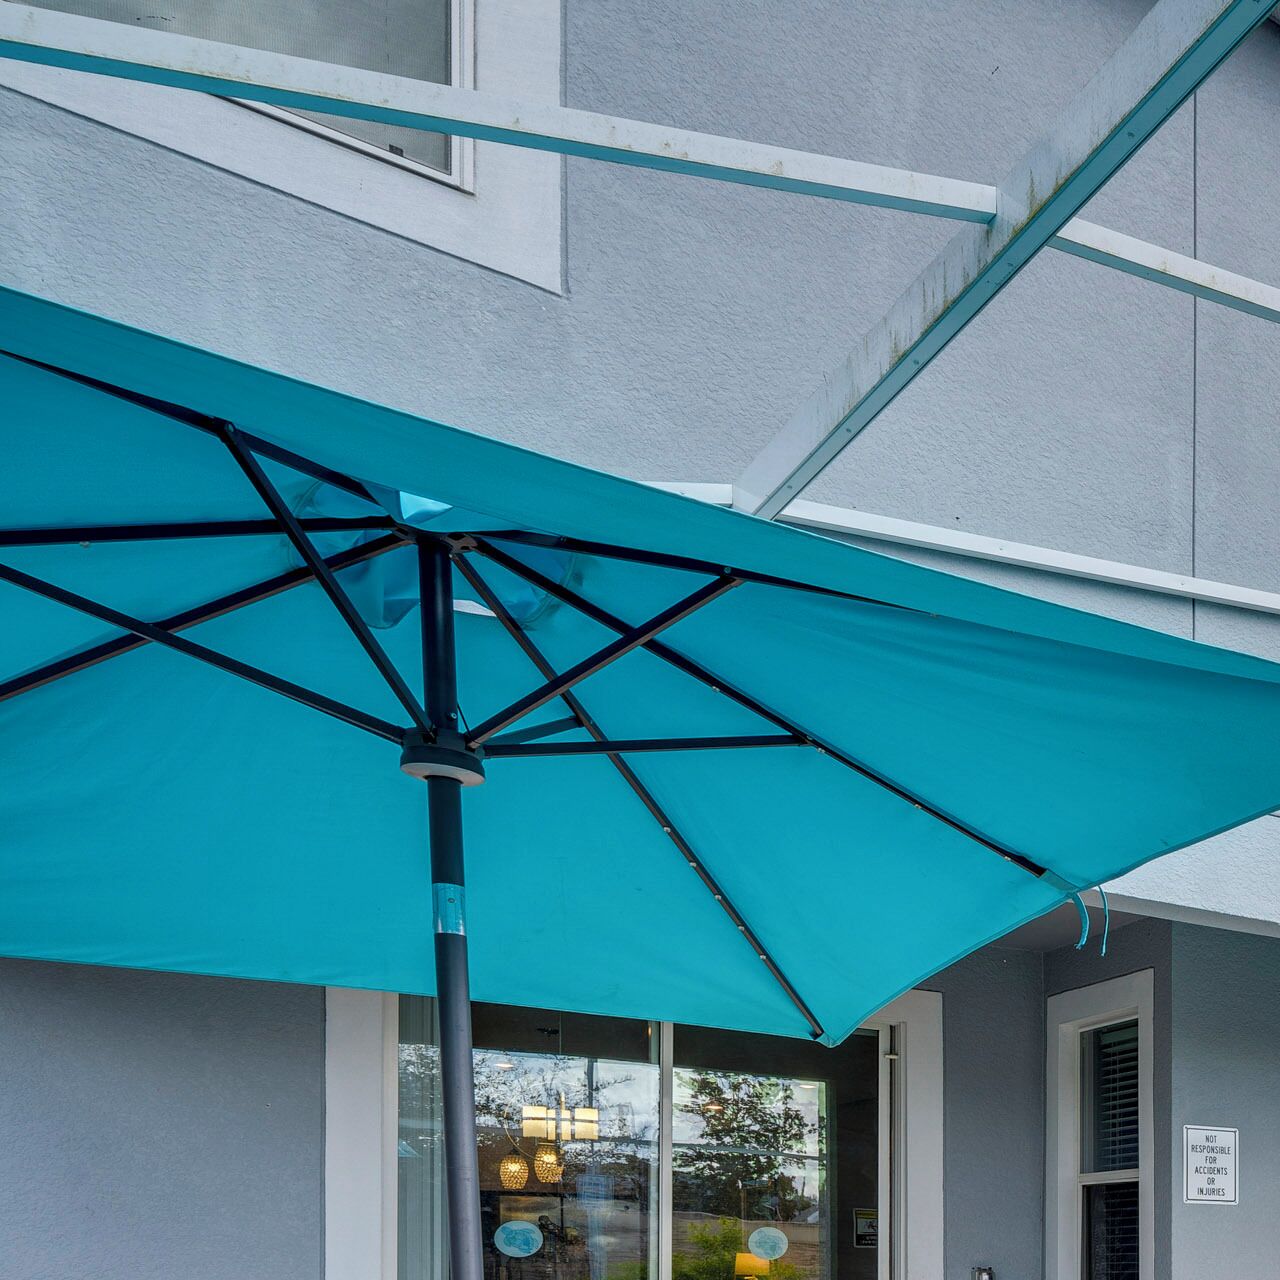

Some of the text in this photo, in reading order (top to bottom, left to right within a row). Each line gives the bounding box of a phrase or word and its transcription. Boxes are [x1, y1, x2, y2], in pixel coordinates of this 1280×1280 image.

[1205, 1135, 1217, 1143] NOT
[1191, 1144, 1231, 1155] RESPONSIBLE
[1205, 1156, 1217, 1164] FOR
[1194, 1166, 1228, 1175] ACCIDENTS
[1207, 1177, 1215, 1185] OR
[1197, 1187, 1225, 1196] INJURIES
